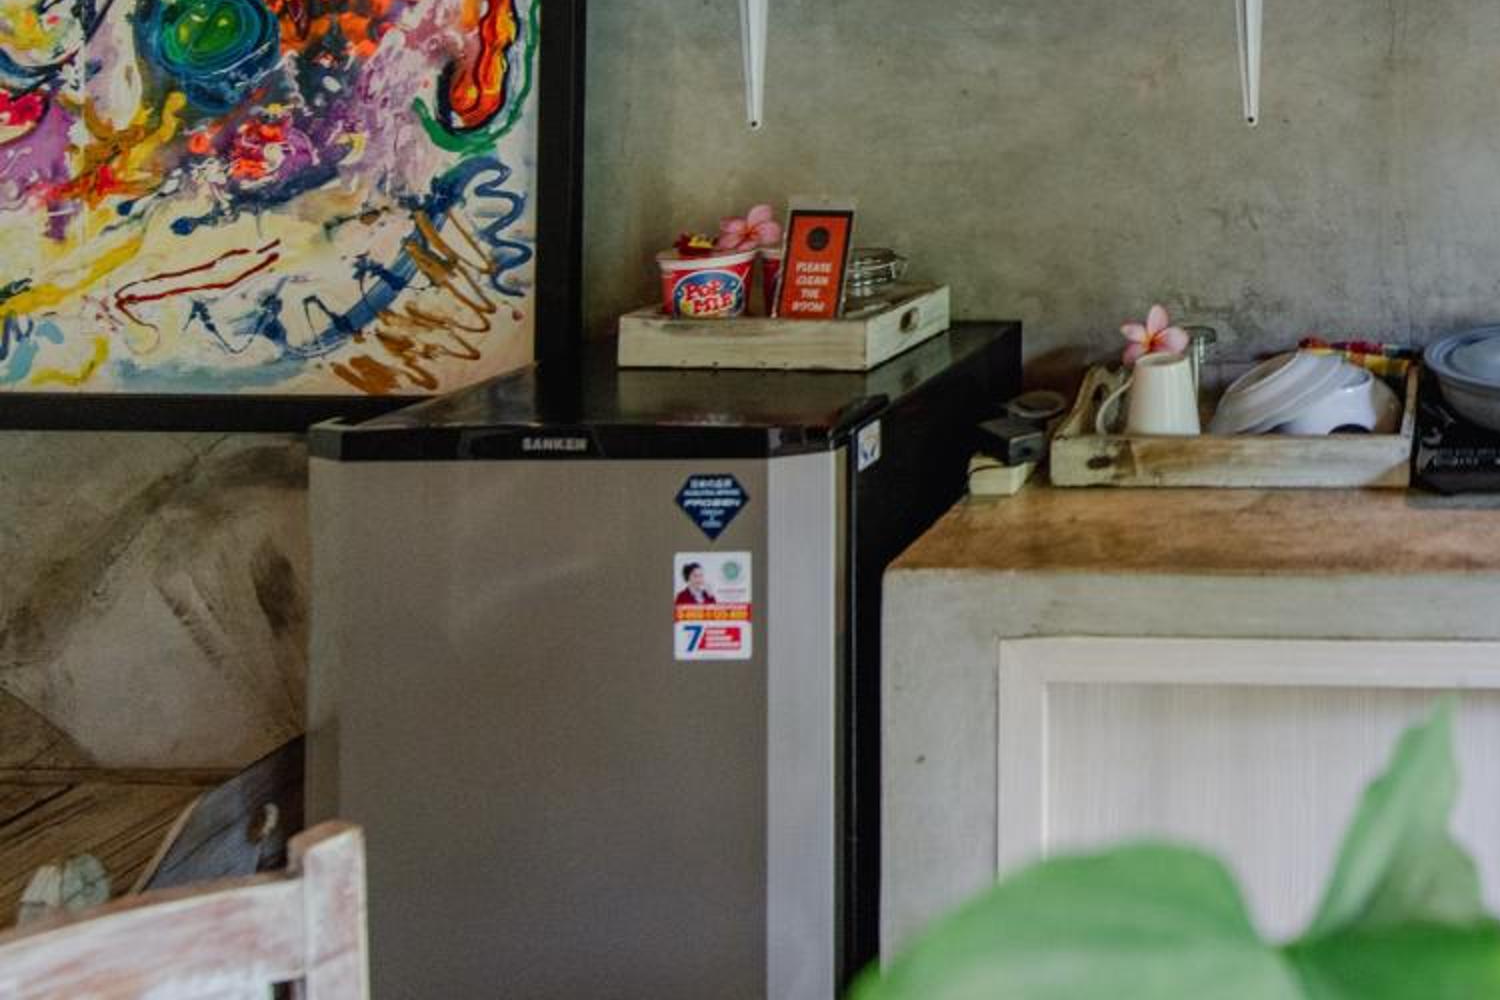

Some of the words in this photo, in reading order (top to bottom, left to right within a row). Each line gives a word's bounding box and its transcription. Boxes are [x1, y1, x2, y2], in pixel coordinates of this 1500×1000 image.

[796, 262, 833, 273] PLEASE
[795, 276, 829, 286] CLEAN
[792, 301, 825, 312] ROOM
[522, 437, 587, 451] SANKEN
[683, 625, 704, 652] 7
